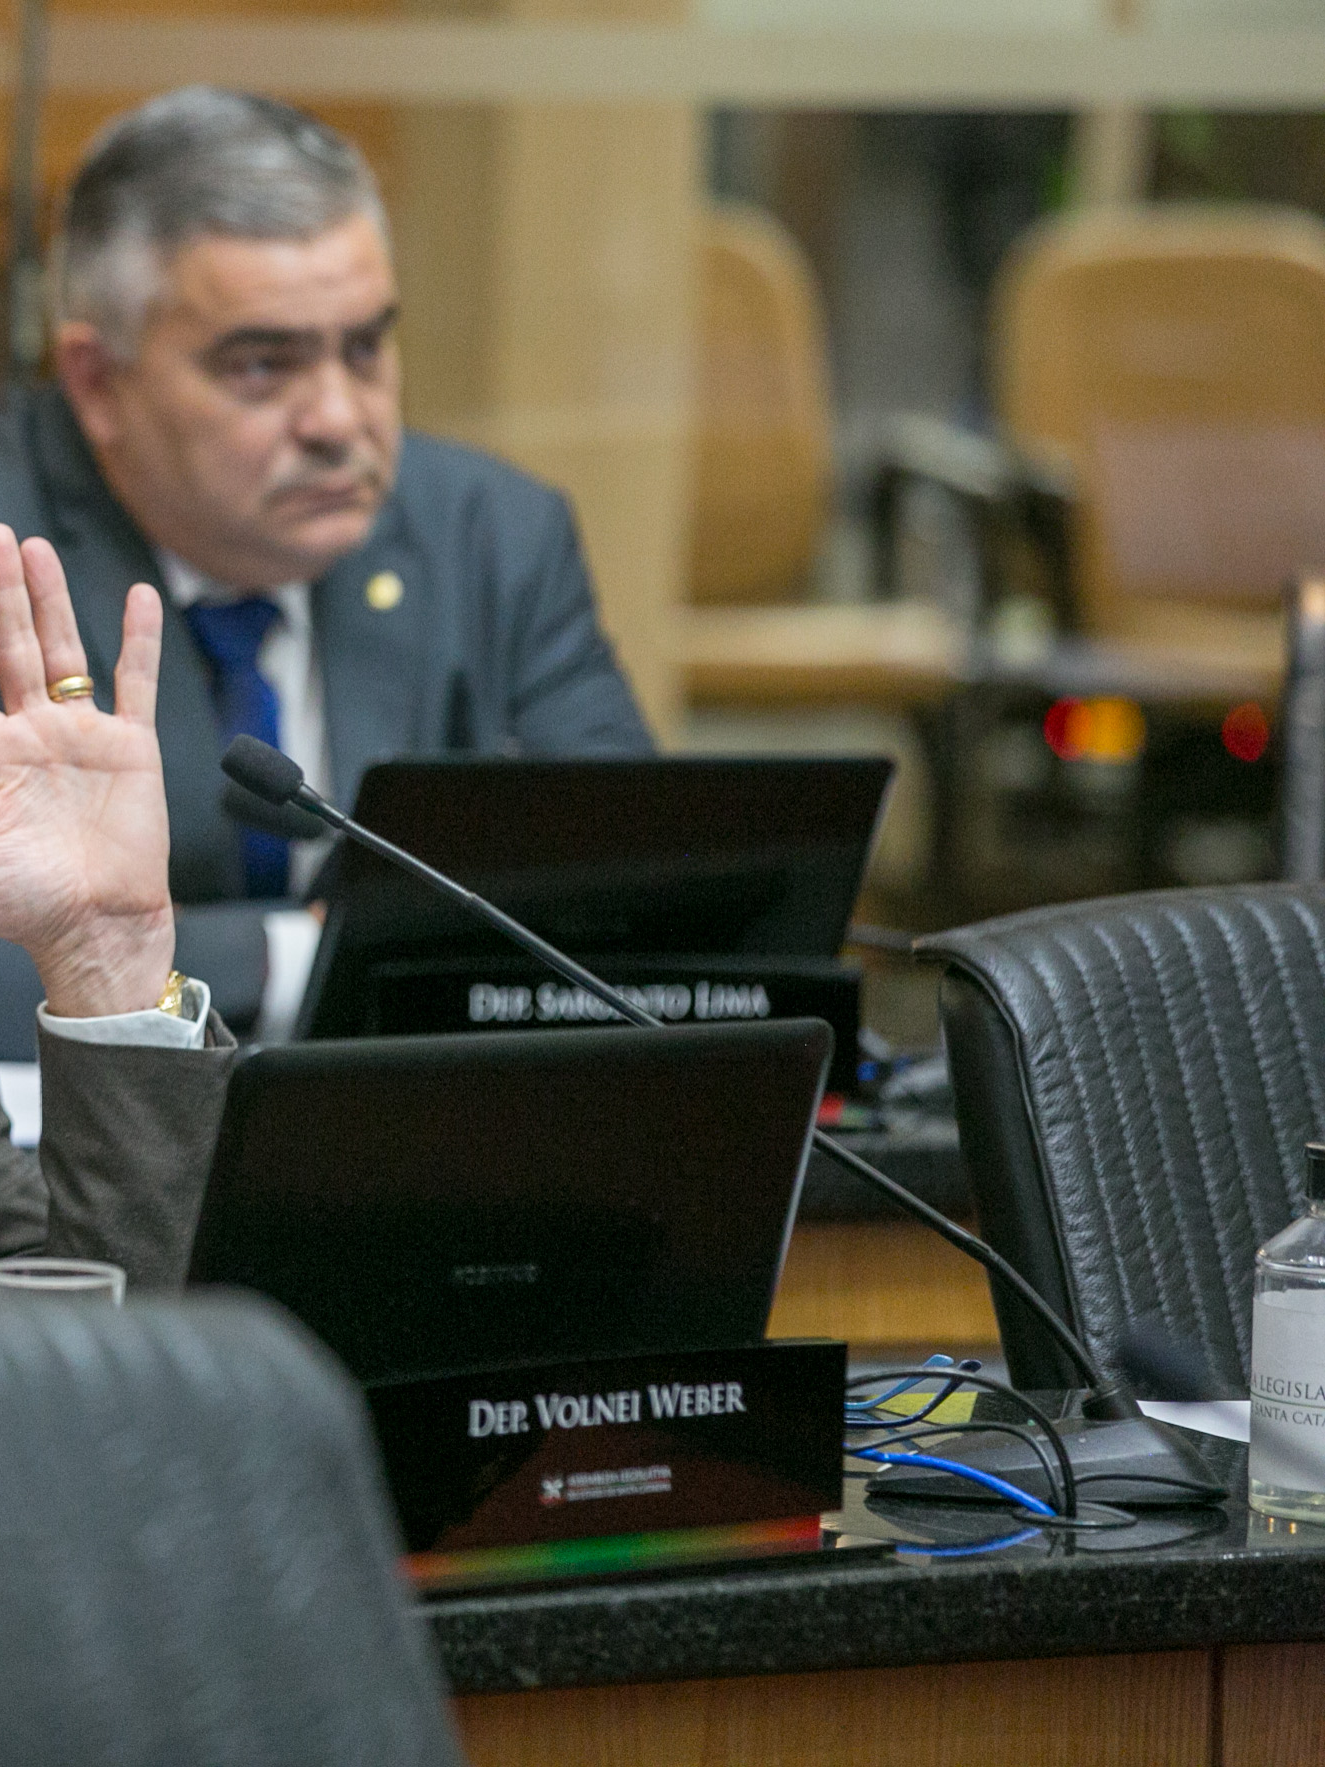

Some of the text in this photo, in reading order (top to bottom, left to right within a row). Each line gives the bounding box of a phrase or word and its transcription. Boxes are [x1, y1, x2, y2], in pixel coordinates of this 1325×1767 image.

[468, 1382, 746, 1437] DEP. VOLNEI WEBER
